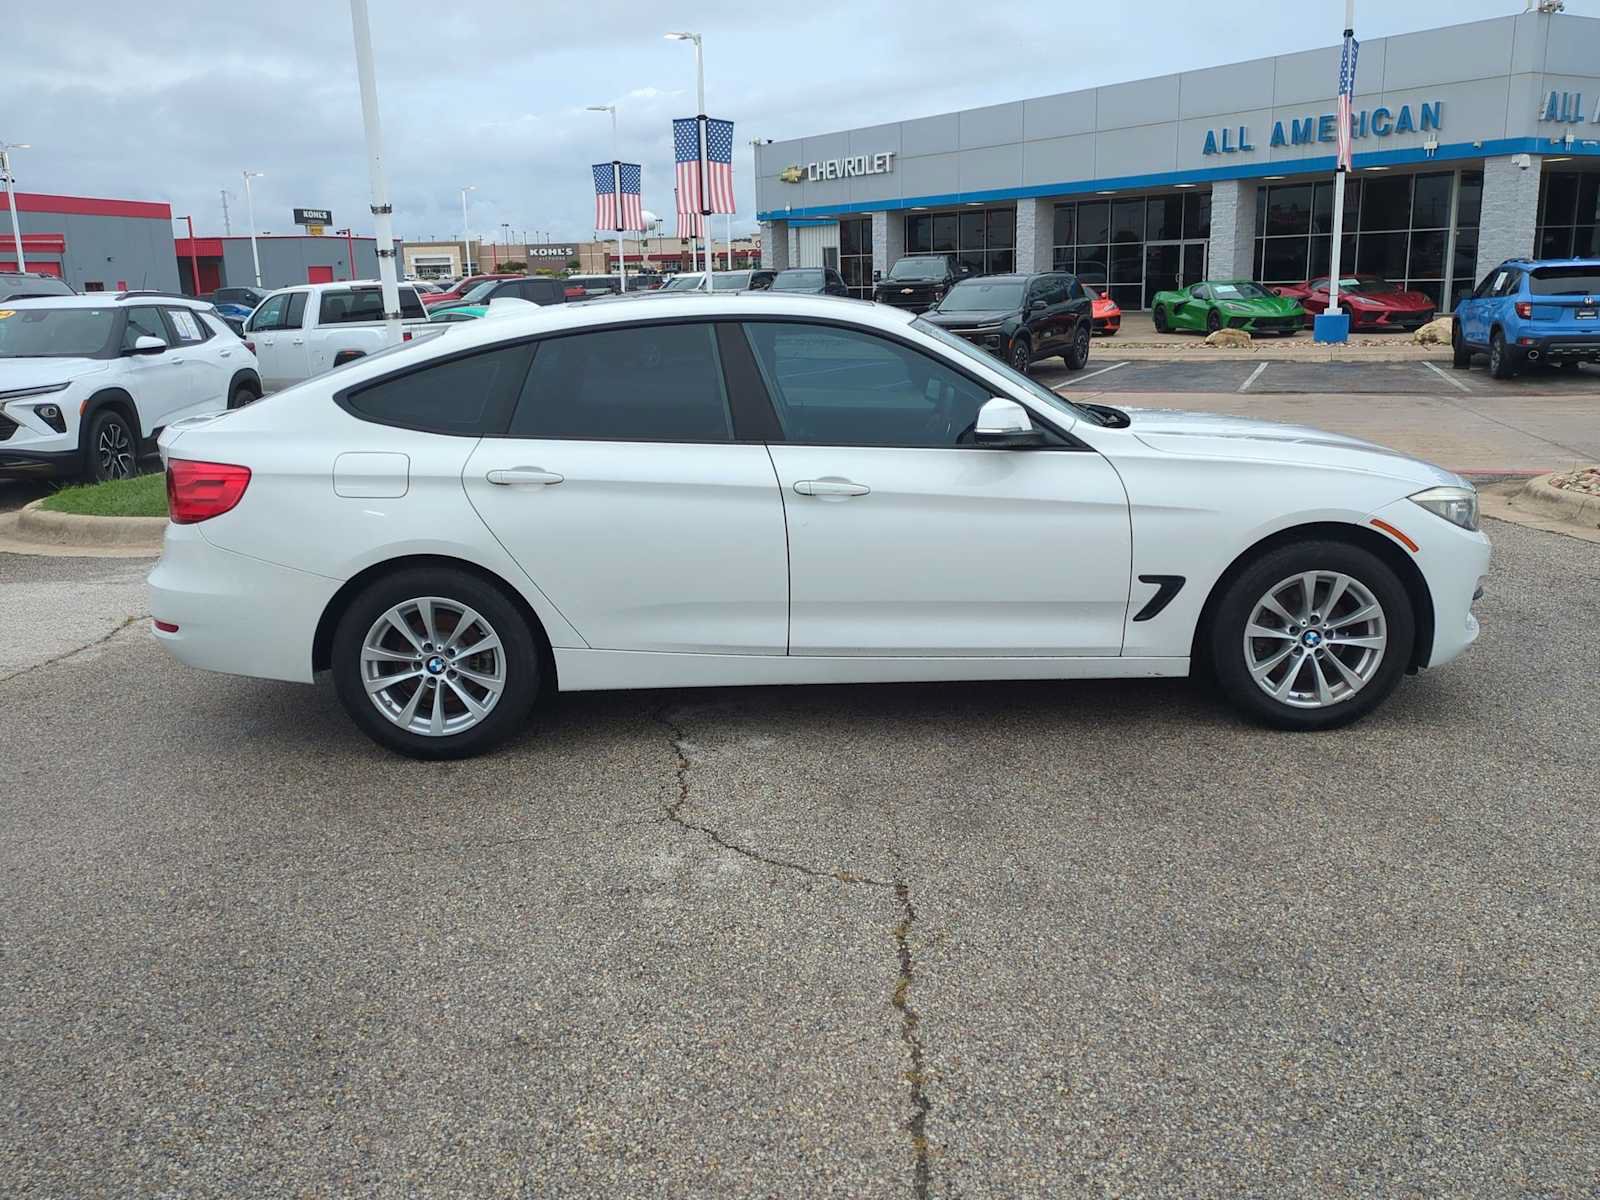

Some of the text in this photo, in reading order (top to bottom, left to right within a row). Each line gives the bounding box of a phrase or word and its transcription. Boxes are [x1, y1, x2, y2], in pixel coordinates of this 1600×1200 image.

[1538, 91, 1585, 123] ALL
[1202, 126, 1255, 155] ALL
[807, 152, 893, 182] CHEVROLET
[529, 247, 574, 256] KOHL'S
